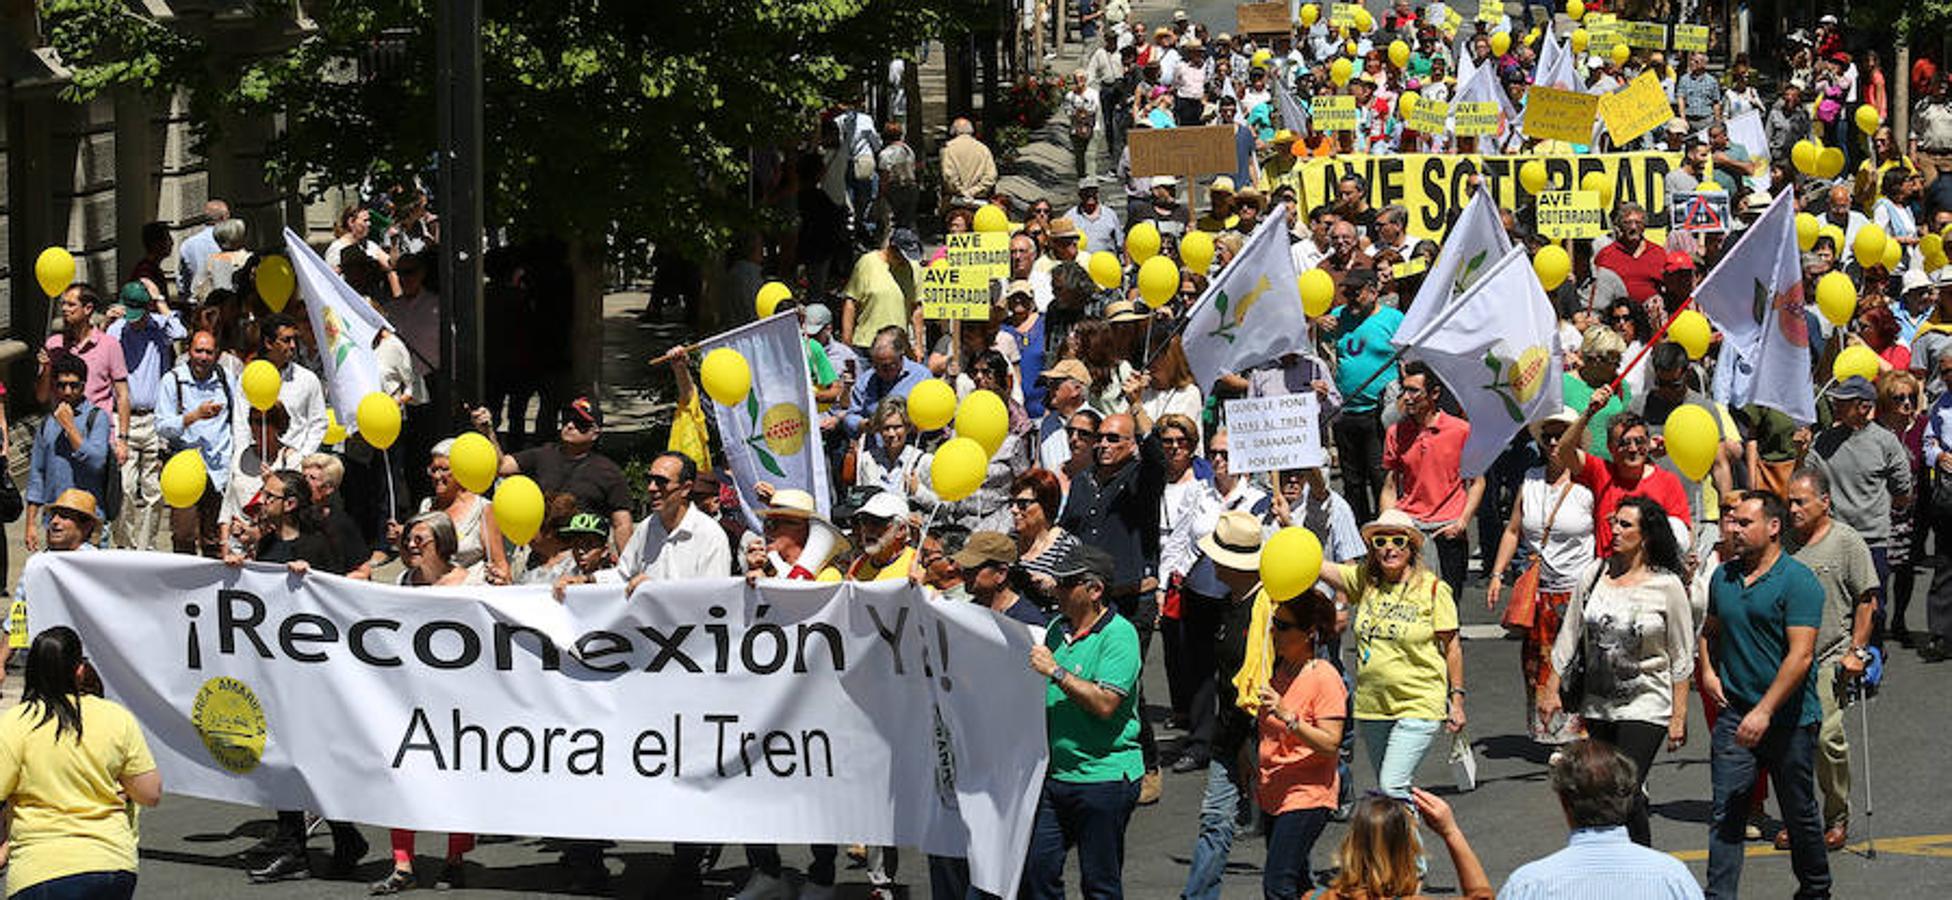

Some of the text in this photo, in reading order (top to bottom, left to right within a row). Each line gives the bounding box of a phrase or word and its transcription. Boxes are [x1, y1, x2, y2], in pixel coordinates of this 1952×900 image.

[1314, 98, 1337, 107] AVE
[1456, 103, 1480, 113] AVE
[1325, 158, 1404, 212] AVE
[1540, 192, 1573, 207] AVE
[1538, 210, 1600, 224] SOTERRADO
[949, 234, 982, 249] AVE
[948, 249, 1009, 267] SOTERRADO
[924, 269, 960, 285] AVE
[923, 287, 988, 304] SOTERRADO
[1279, 397, 1307, 409] PONE
[185, 588, 846, 674] ¡Reconexión
[391, 708, 834, 778] Ahora el Tren
